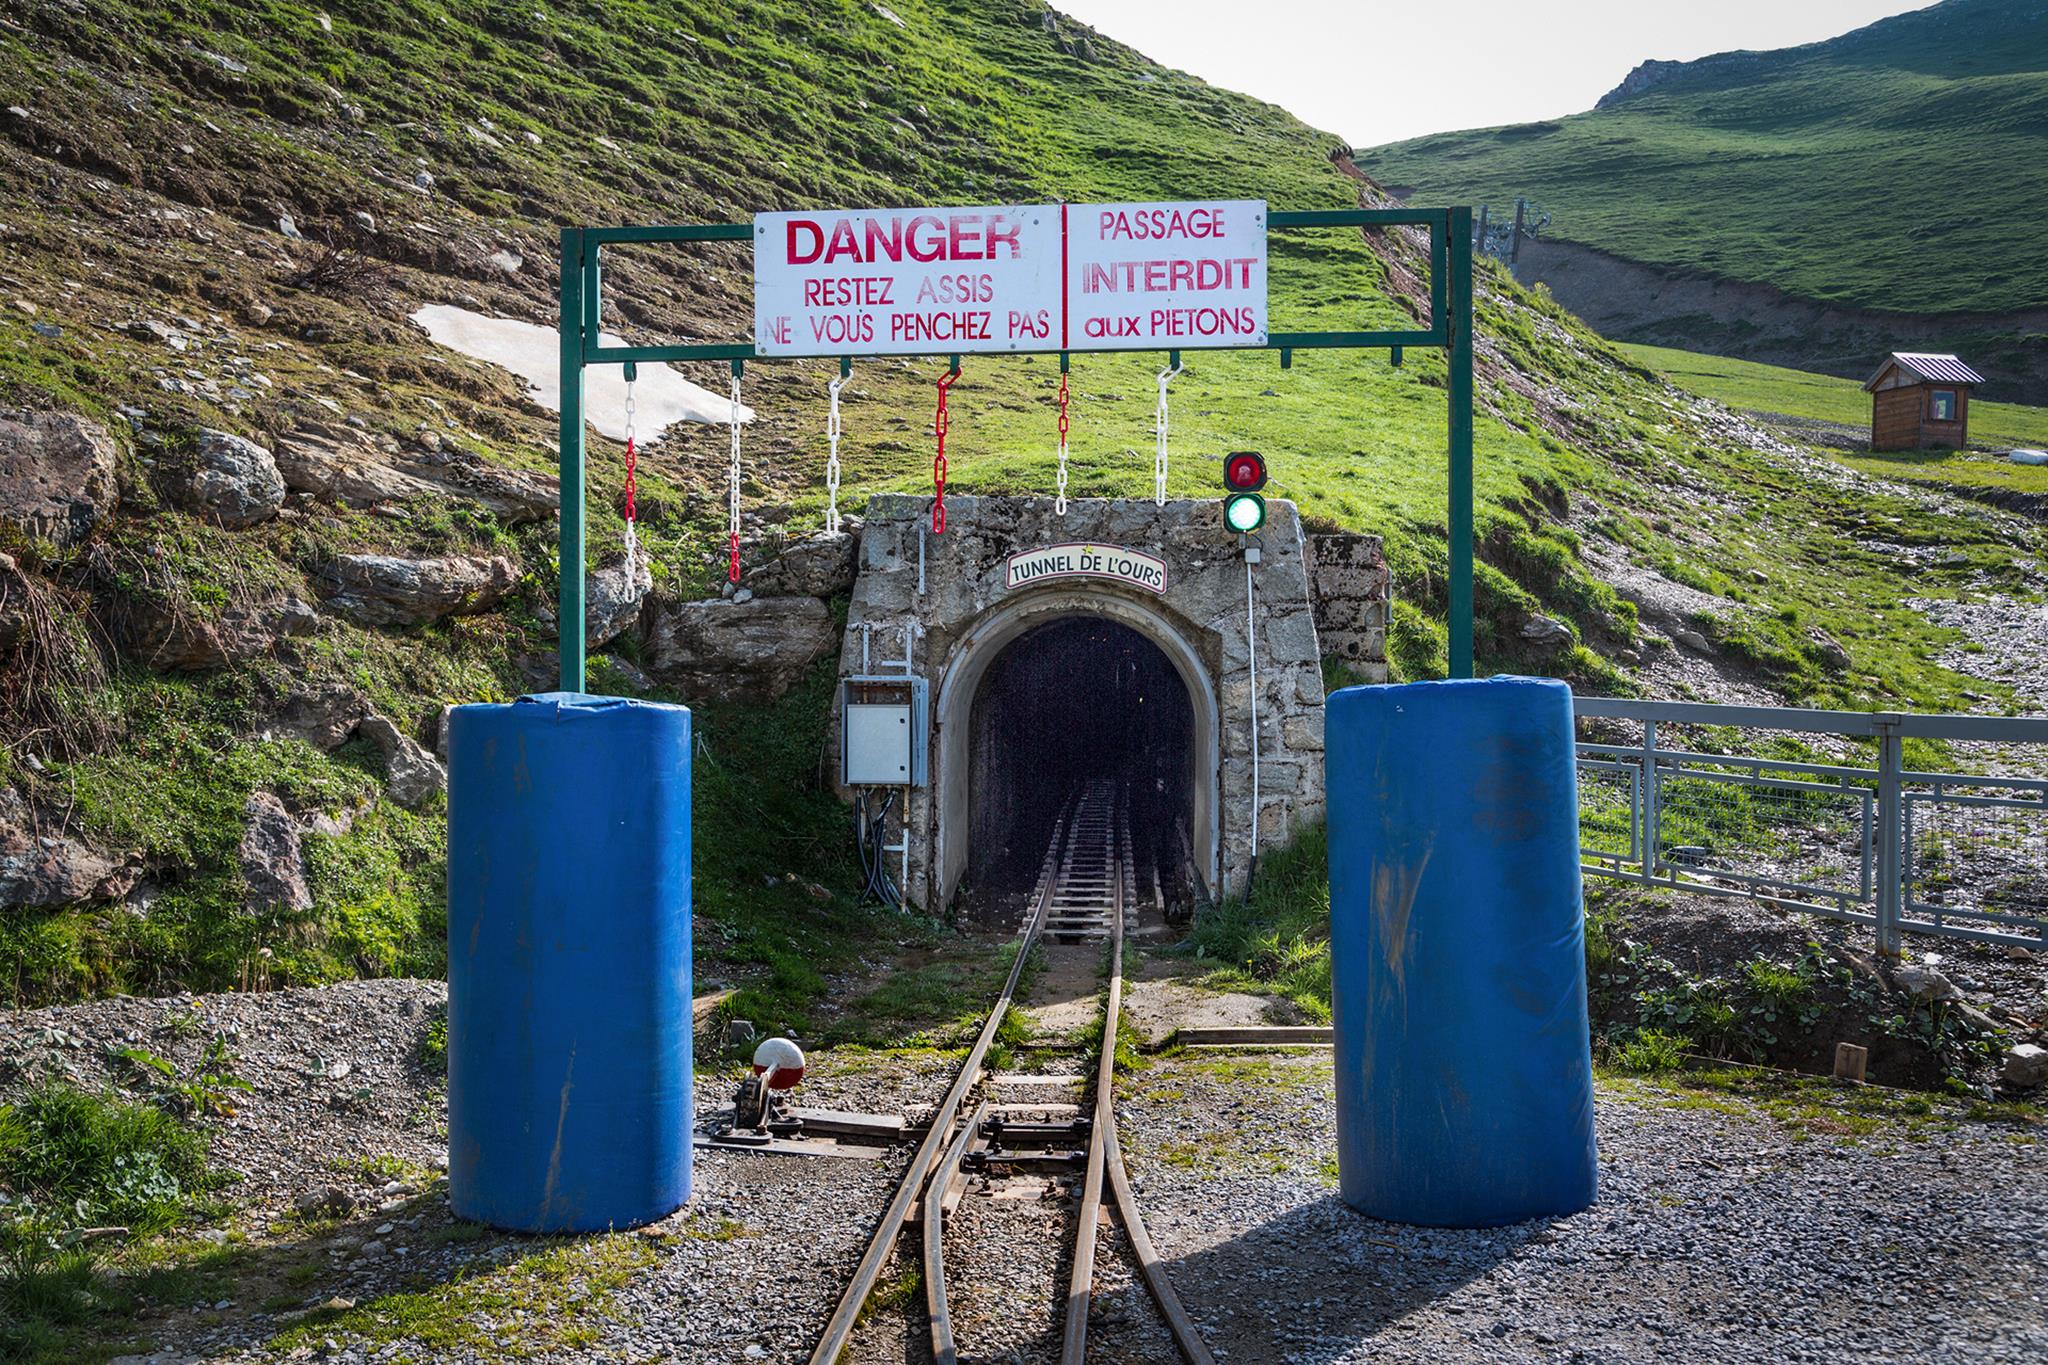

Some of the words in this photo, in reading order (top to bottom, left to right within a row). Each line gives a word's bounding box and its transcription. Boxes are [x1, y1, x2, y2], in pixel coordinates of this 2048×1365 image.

[786, 215, 1021, 265] DANGER
[1100, 208, 1225, 240] PASSAGE
[804, 277, 894, 307] RESTEZ
[916, 274, 993, 304] ASSIS
[1082, 258, 1258, 294] INTERDIT
[764, 316, 791, 344] NE
[809, 313, 873, 344] VOUS
[891, 311, 991, 342] PENCHEZ
[1008, 309, 1050, 339] PAS
[1084, 316, 1141, 338] aux
[1151, 307, 1255, 336] PIETONS
[1012, 555, 1074, 582] TUNNEL
[1080, 555, 1102, 571] DE
[1108, 557, 1163, 587] L'OURS
